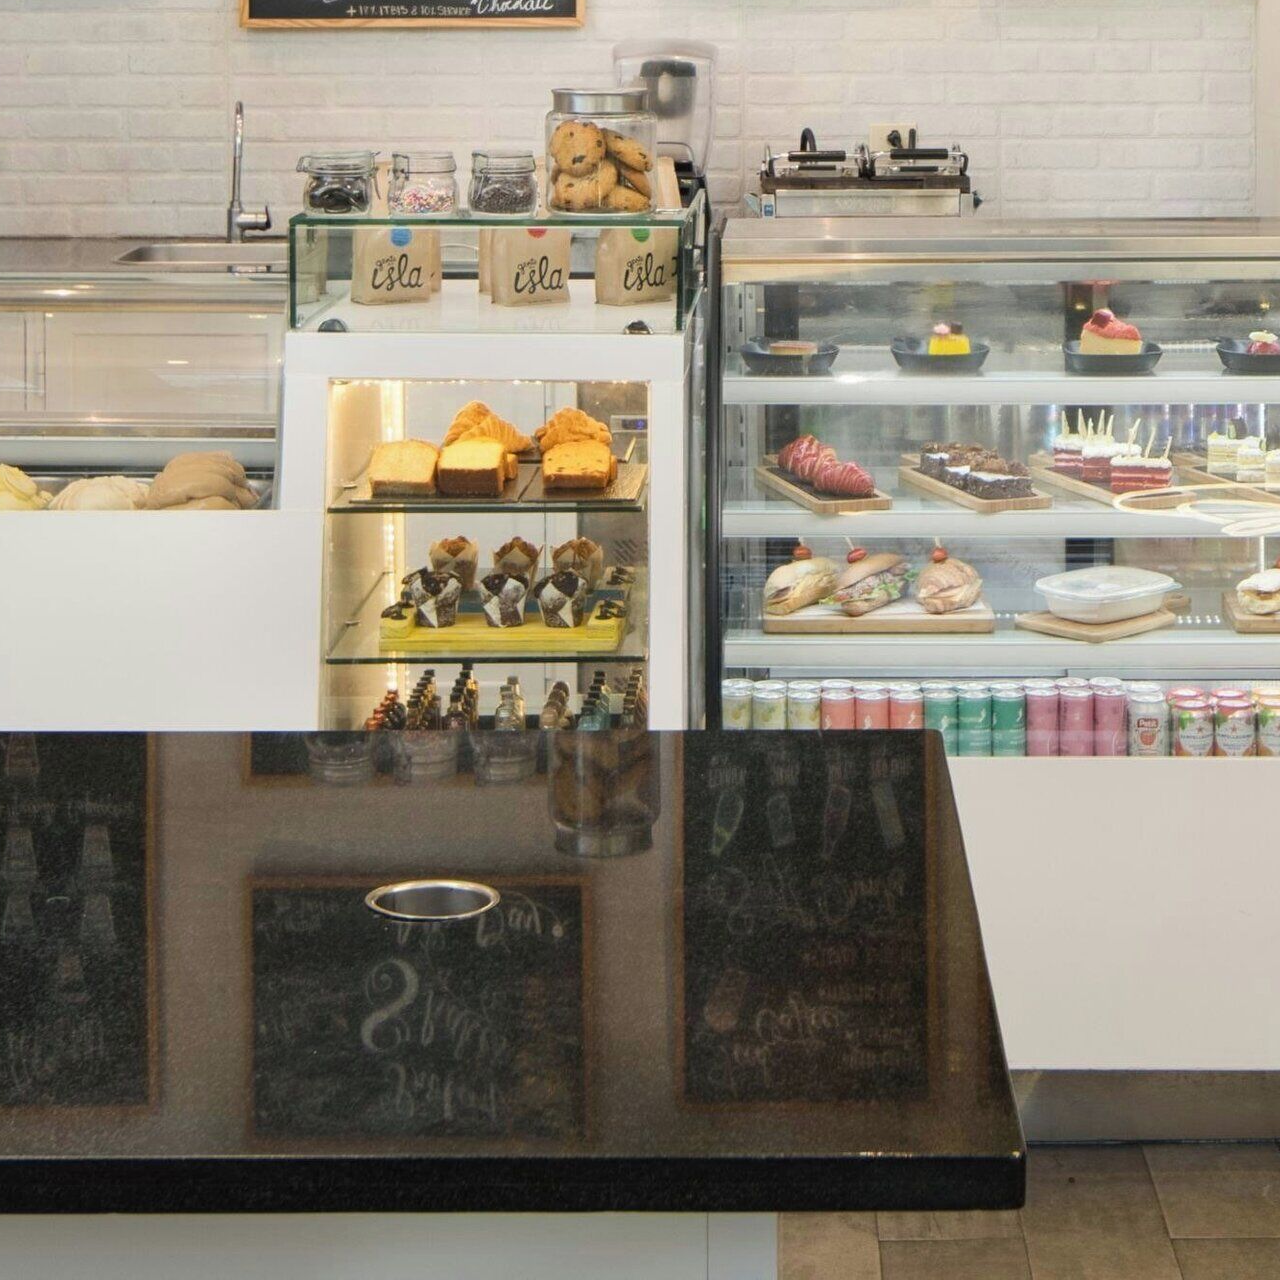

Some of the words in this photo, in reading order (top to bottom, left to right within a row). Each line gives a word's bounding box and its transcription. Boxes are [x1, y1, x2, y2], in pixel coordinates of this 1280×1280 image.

[372, 253, 424, 291] isla
[514, 256, 564, 294] isla
[624, 252, 667, 291] isla
